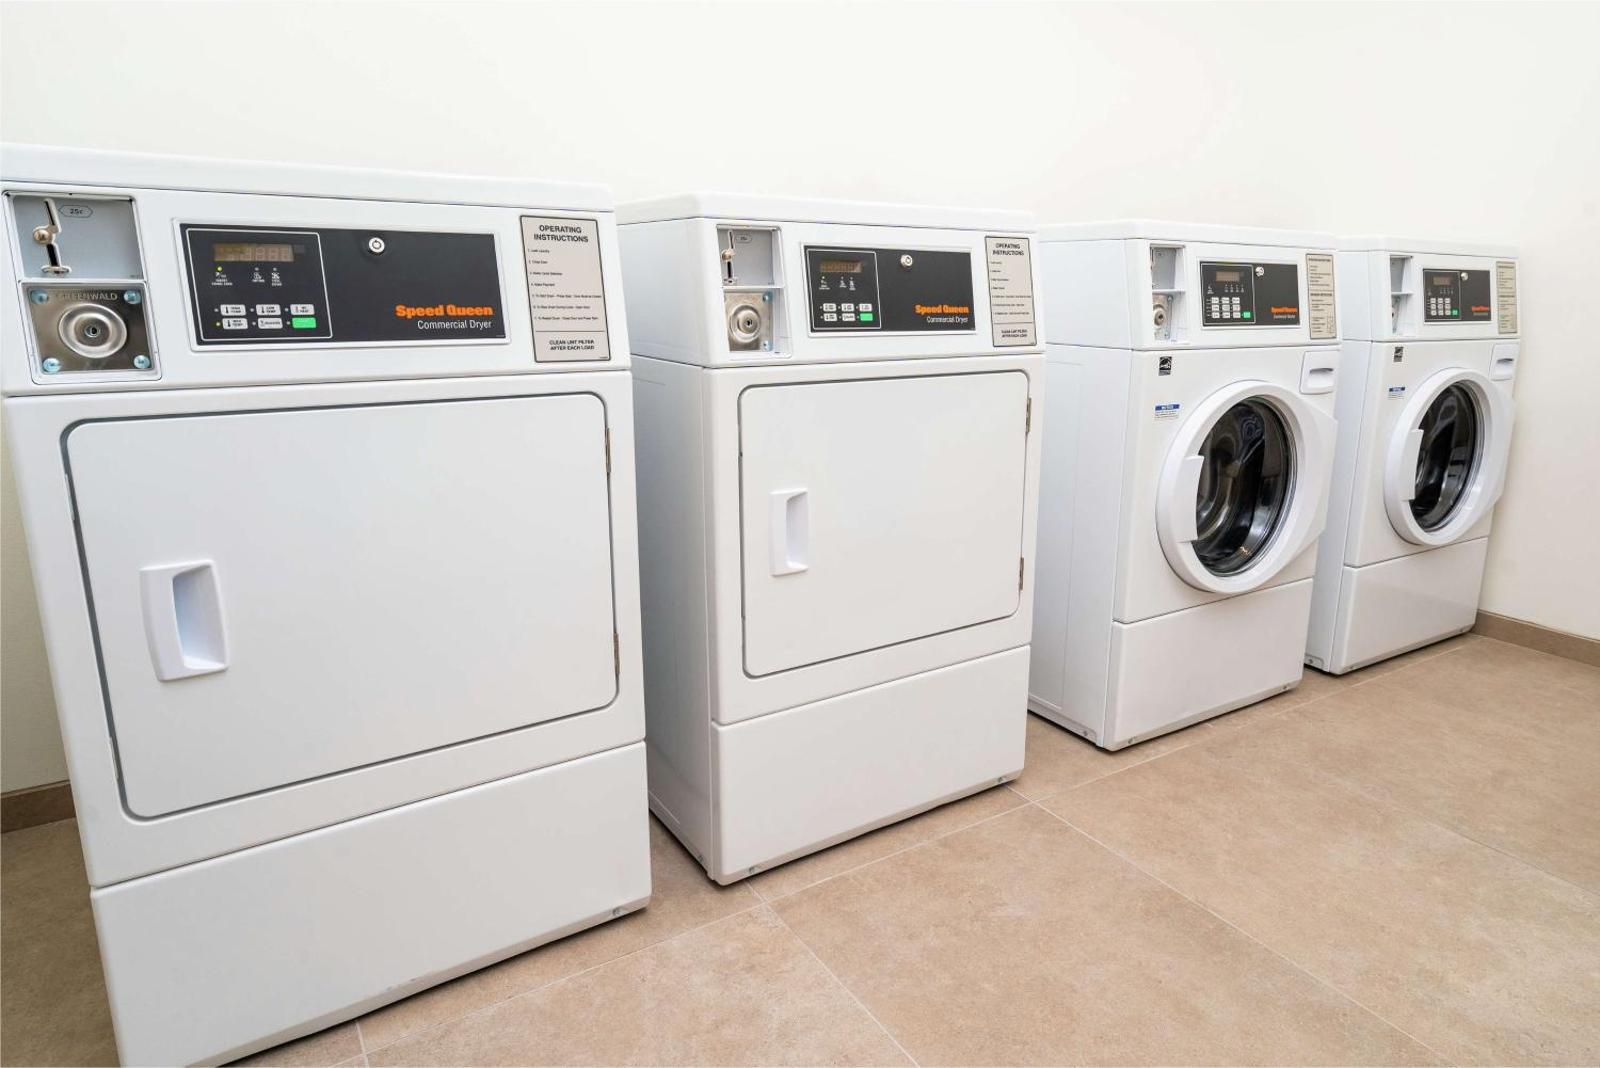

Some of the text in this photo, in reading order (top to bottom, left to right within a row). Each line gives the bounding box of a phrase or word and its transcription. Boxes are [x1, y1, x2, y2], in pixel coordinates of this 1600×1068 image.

[540, 224, 582, 233] OPERATING
[534, 234, 588, 242] INSTRUCTIONS
[396, 304, 493, 318] Speed Queen
[914, 304, 969, 315] Speed Queen
[417, 320, 491, 330] Commercial Dryer
